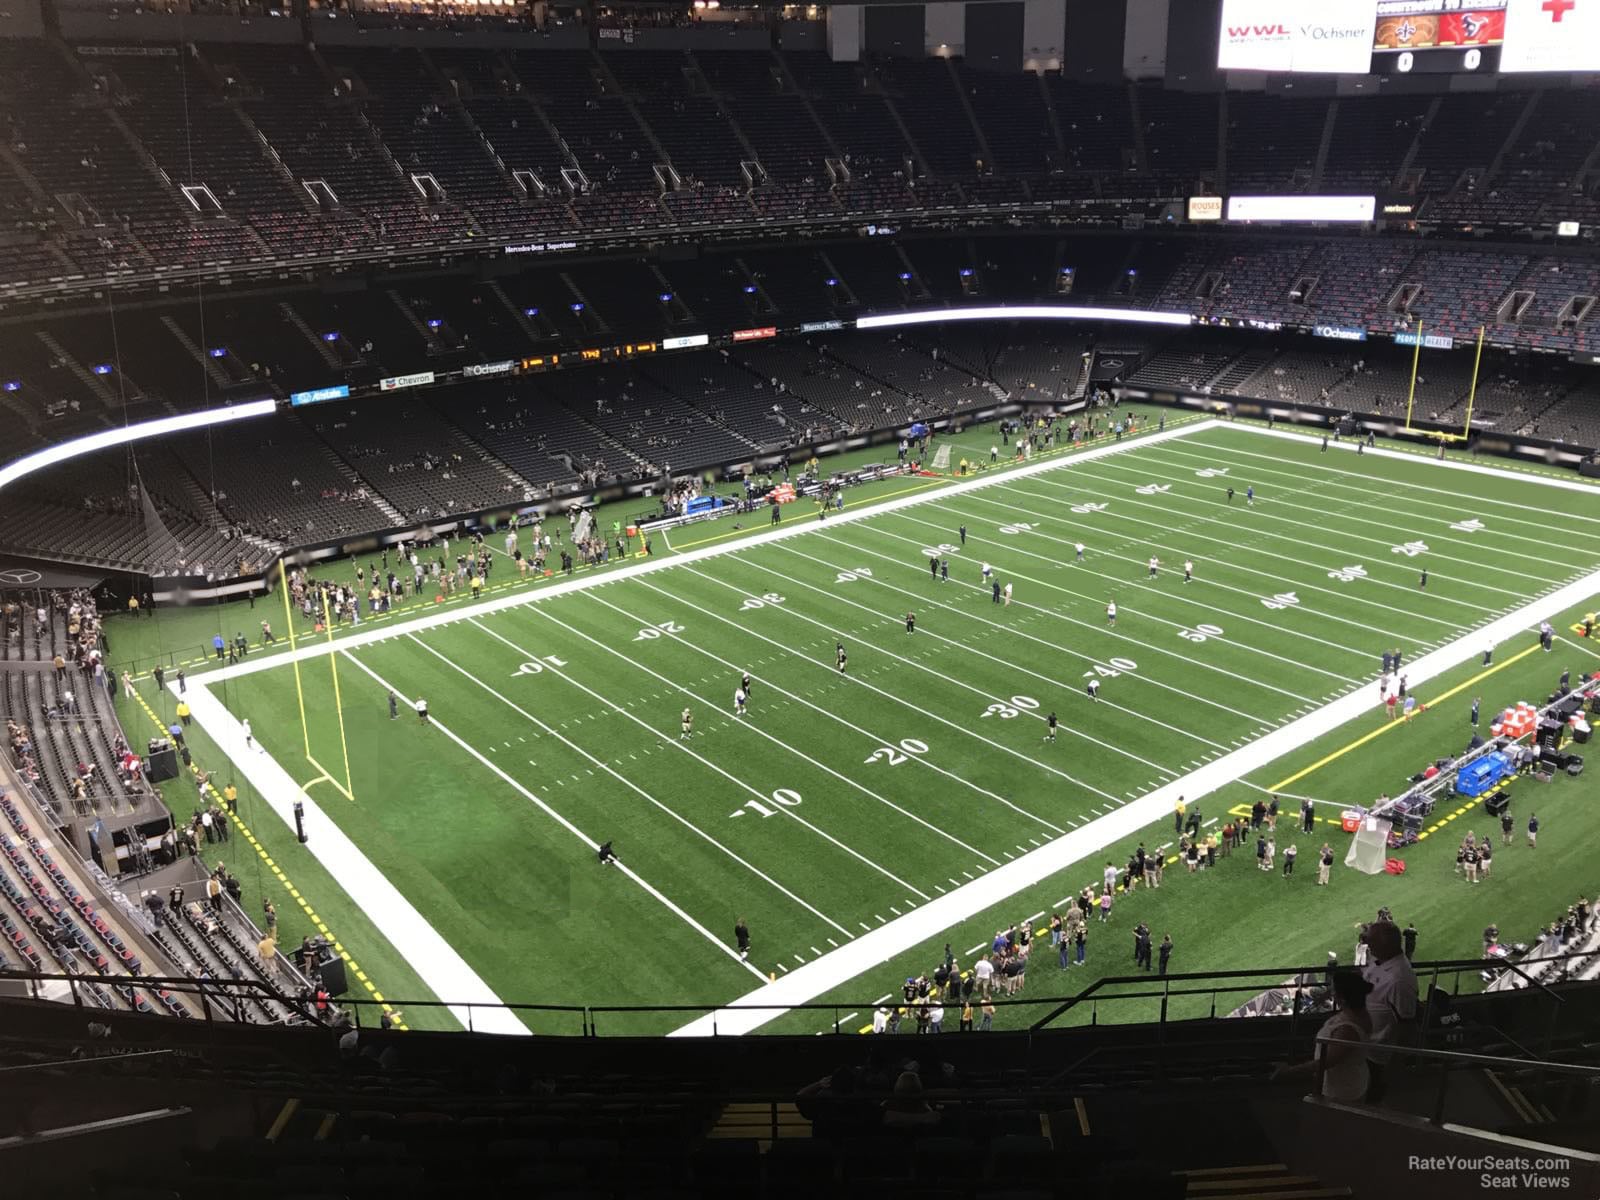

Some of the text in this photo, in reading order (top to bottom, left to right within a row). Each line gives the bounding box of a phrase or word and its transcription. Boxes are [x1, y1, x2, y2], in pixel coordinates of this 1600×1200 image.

[1228, 25, 1290, 37] WWL
[1312, 27, 1365, 40] Ochsner
[1398, 52, 1413, 72] 0
[1465, 49, 1481, 70] 0
[1323, 327, 1362, 341] Ochsner
[473, 363, 511, 376] Ochsner
[398, 375, 430, 386] Chevron
[921, 544, 960, 557] 50
[837, 567, 873, 582] 40
[743, 592, 786, 608] 30
[638, 620, 686, 639] 20
[1177, 624, 1224, 643] 50
[519, 655, 568, 674] 10
[1093, 657, 1138, 678] 40
[987, 695, 1041, 719] 30
[872, 738, 930, 766] 20
[744, 788, 802, 818] 10
